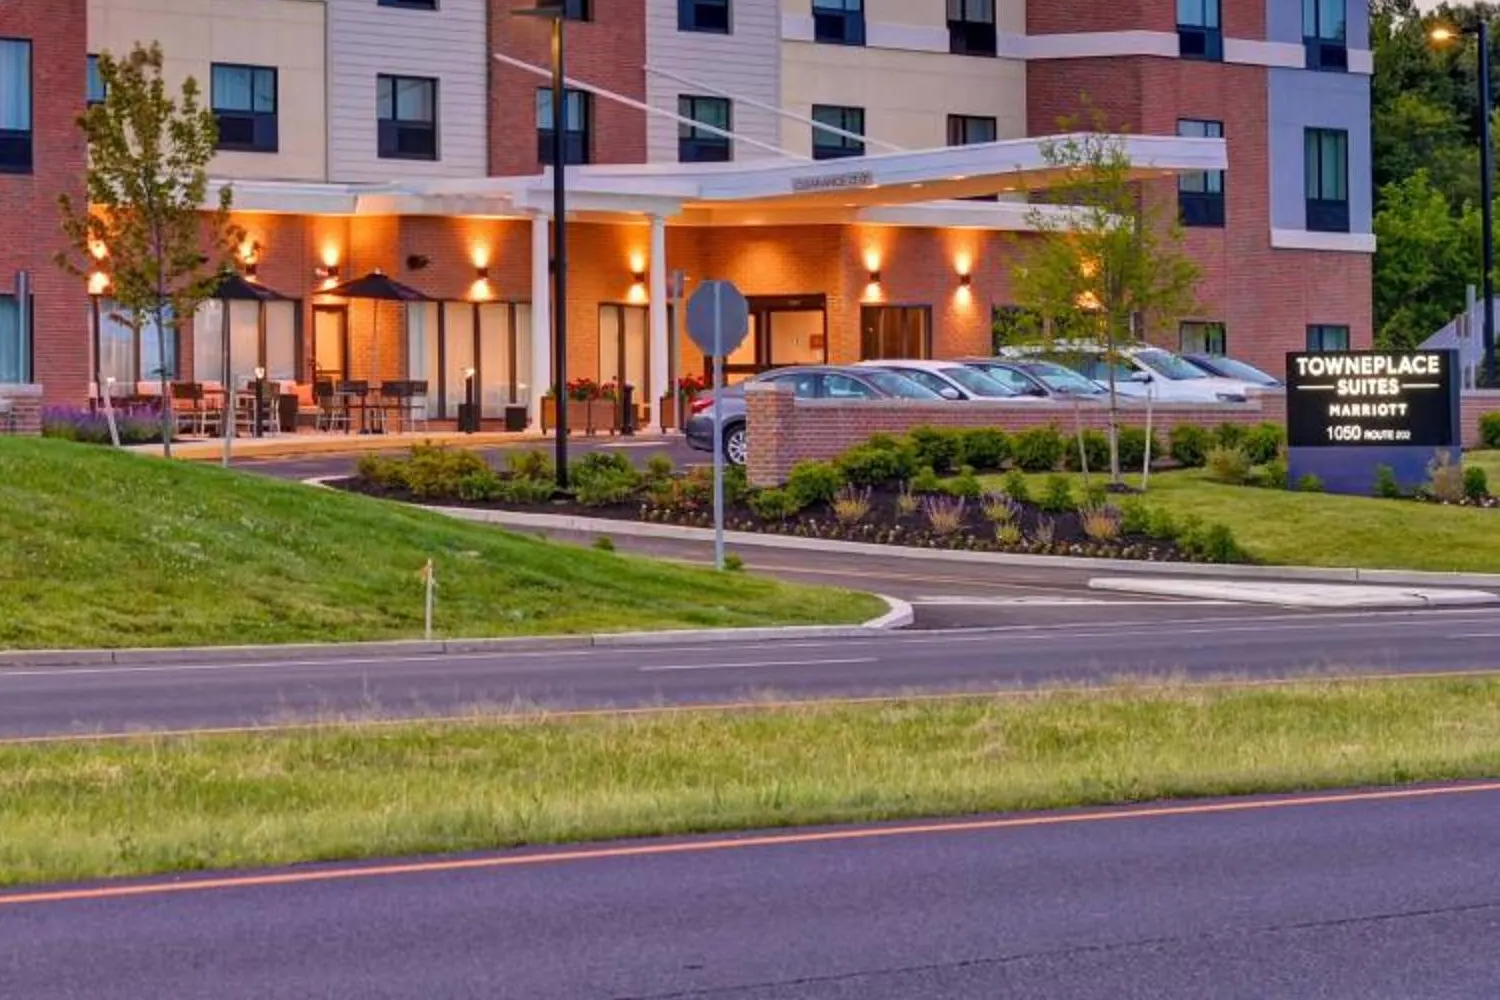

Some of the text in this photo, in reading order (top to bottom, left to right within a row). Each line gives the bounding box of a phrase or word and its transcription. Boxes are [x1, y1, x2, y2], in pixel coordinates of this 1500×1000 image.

[1296, 355, 1441, 377] TOWNEPLACE
[1337, 378, 1401, 396] SUITES
[1328, 403, 1409, 417] MARRIOTT
[1326, 424, 1362, 441] 1050
[1363, 429, 1395, 441] ROUTE
